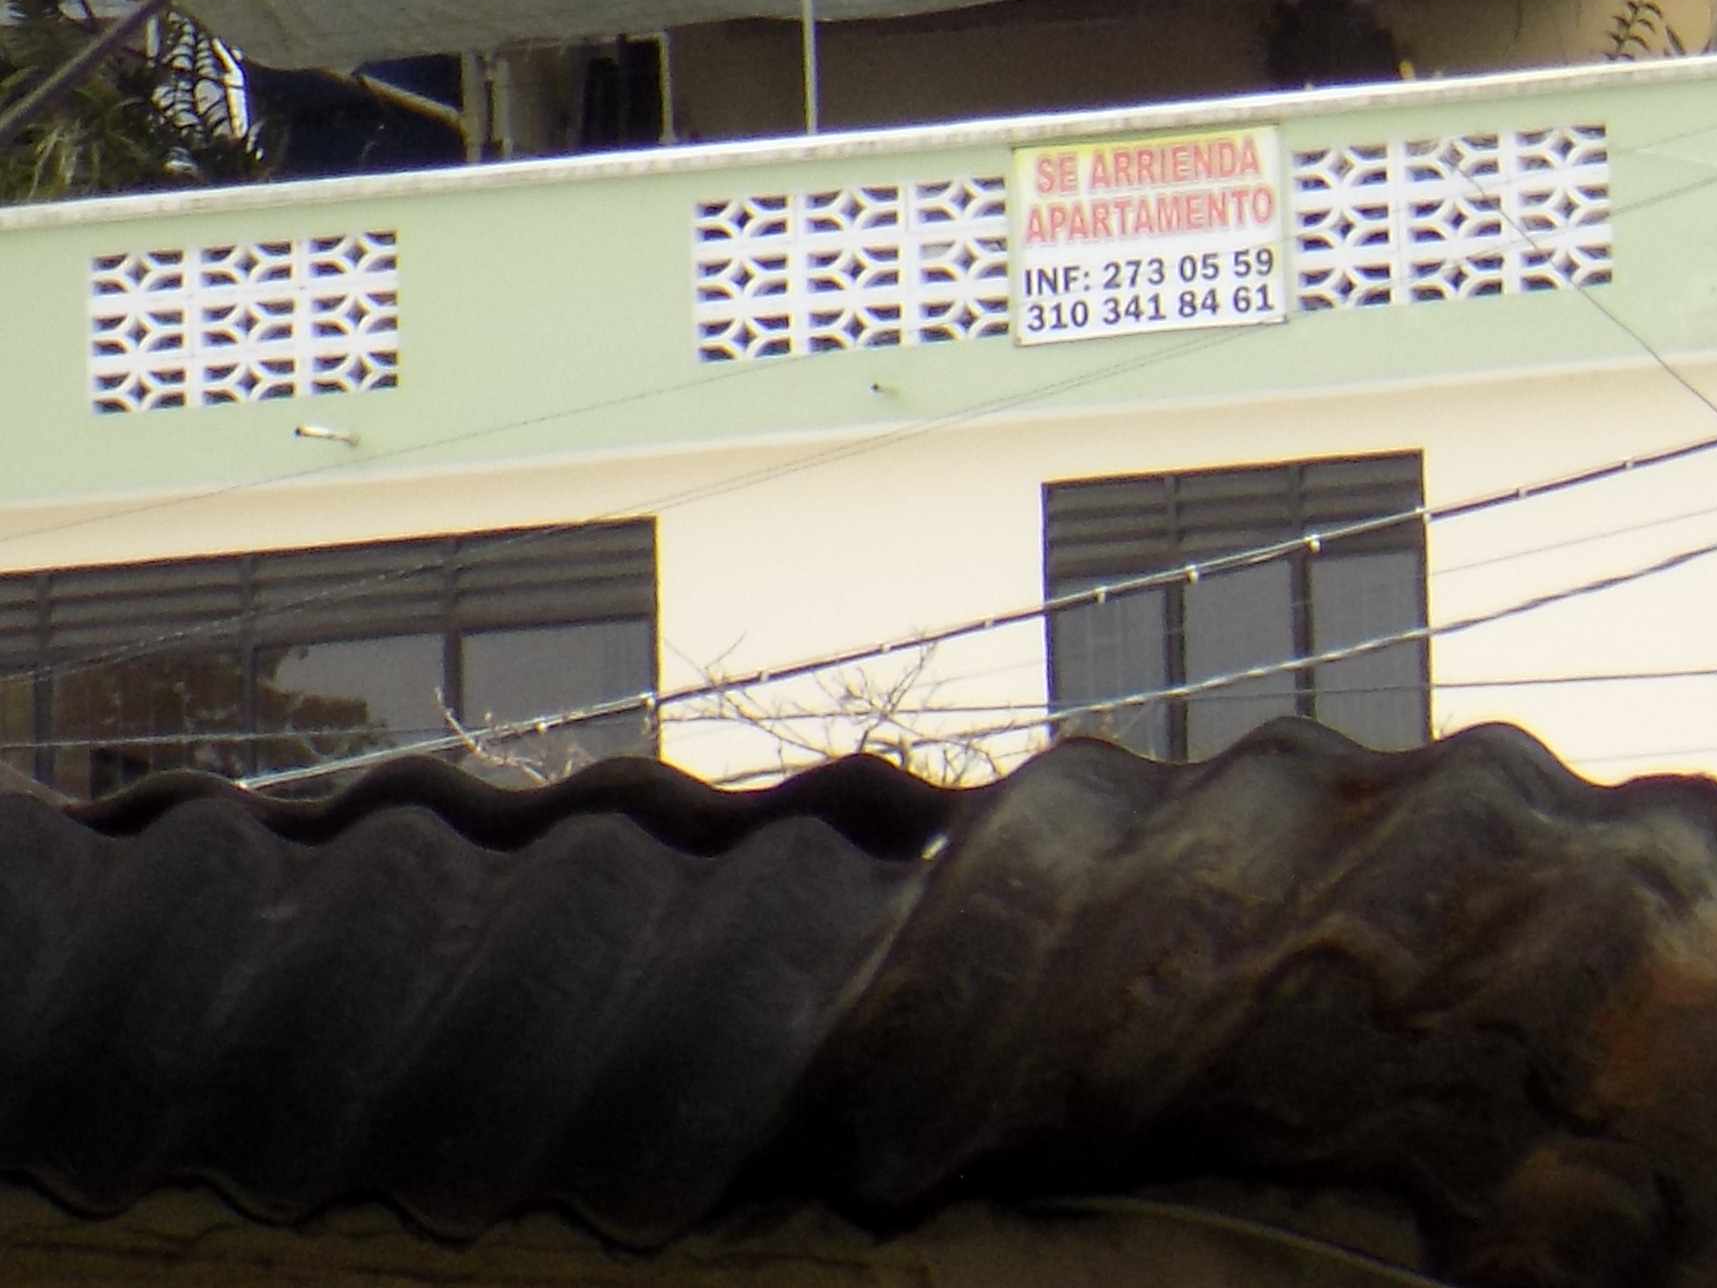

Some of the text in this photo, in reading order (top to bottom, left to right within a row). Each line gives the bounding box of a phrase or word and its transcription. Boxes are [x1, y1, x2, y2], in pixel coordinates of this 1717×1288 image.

[1036, 138, 1259, 194] SE ARRIENDA
[1025, 186, 1274, 244] APARTAMENTO
[1024, 247, 1274, 296] INF: 273 05 59
[1027, 283, 1274, 332] 310 341 84 61
